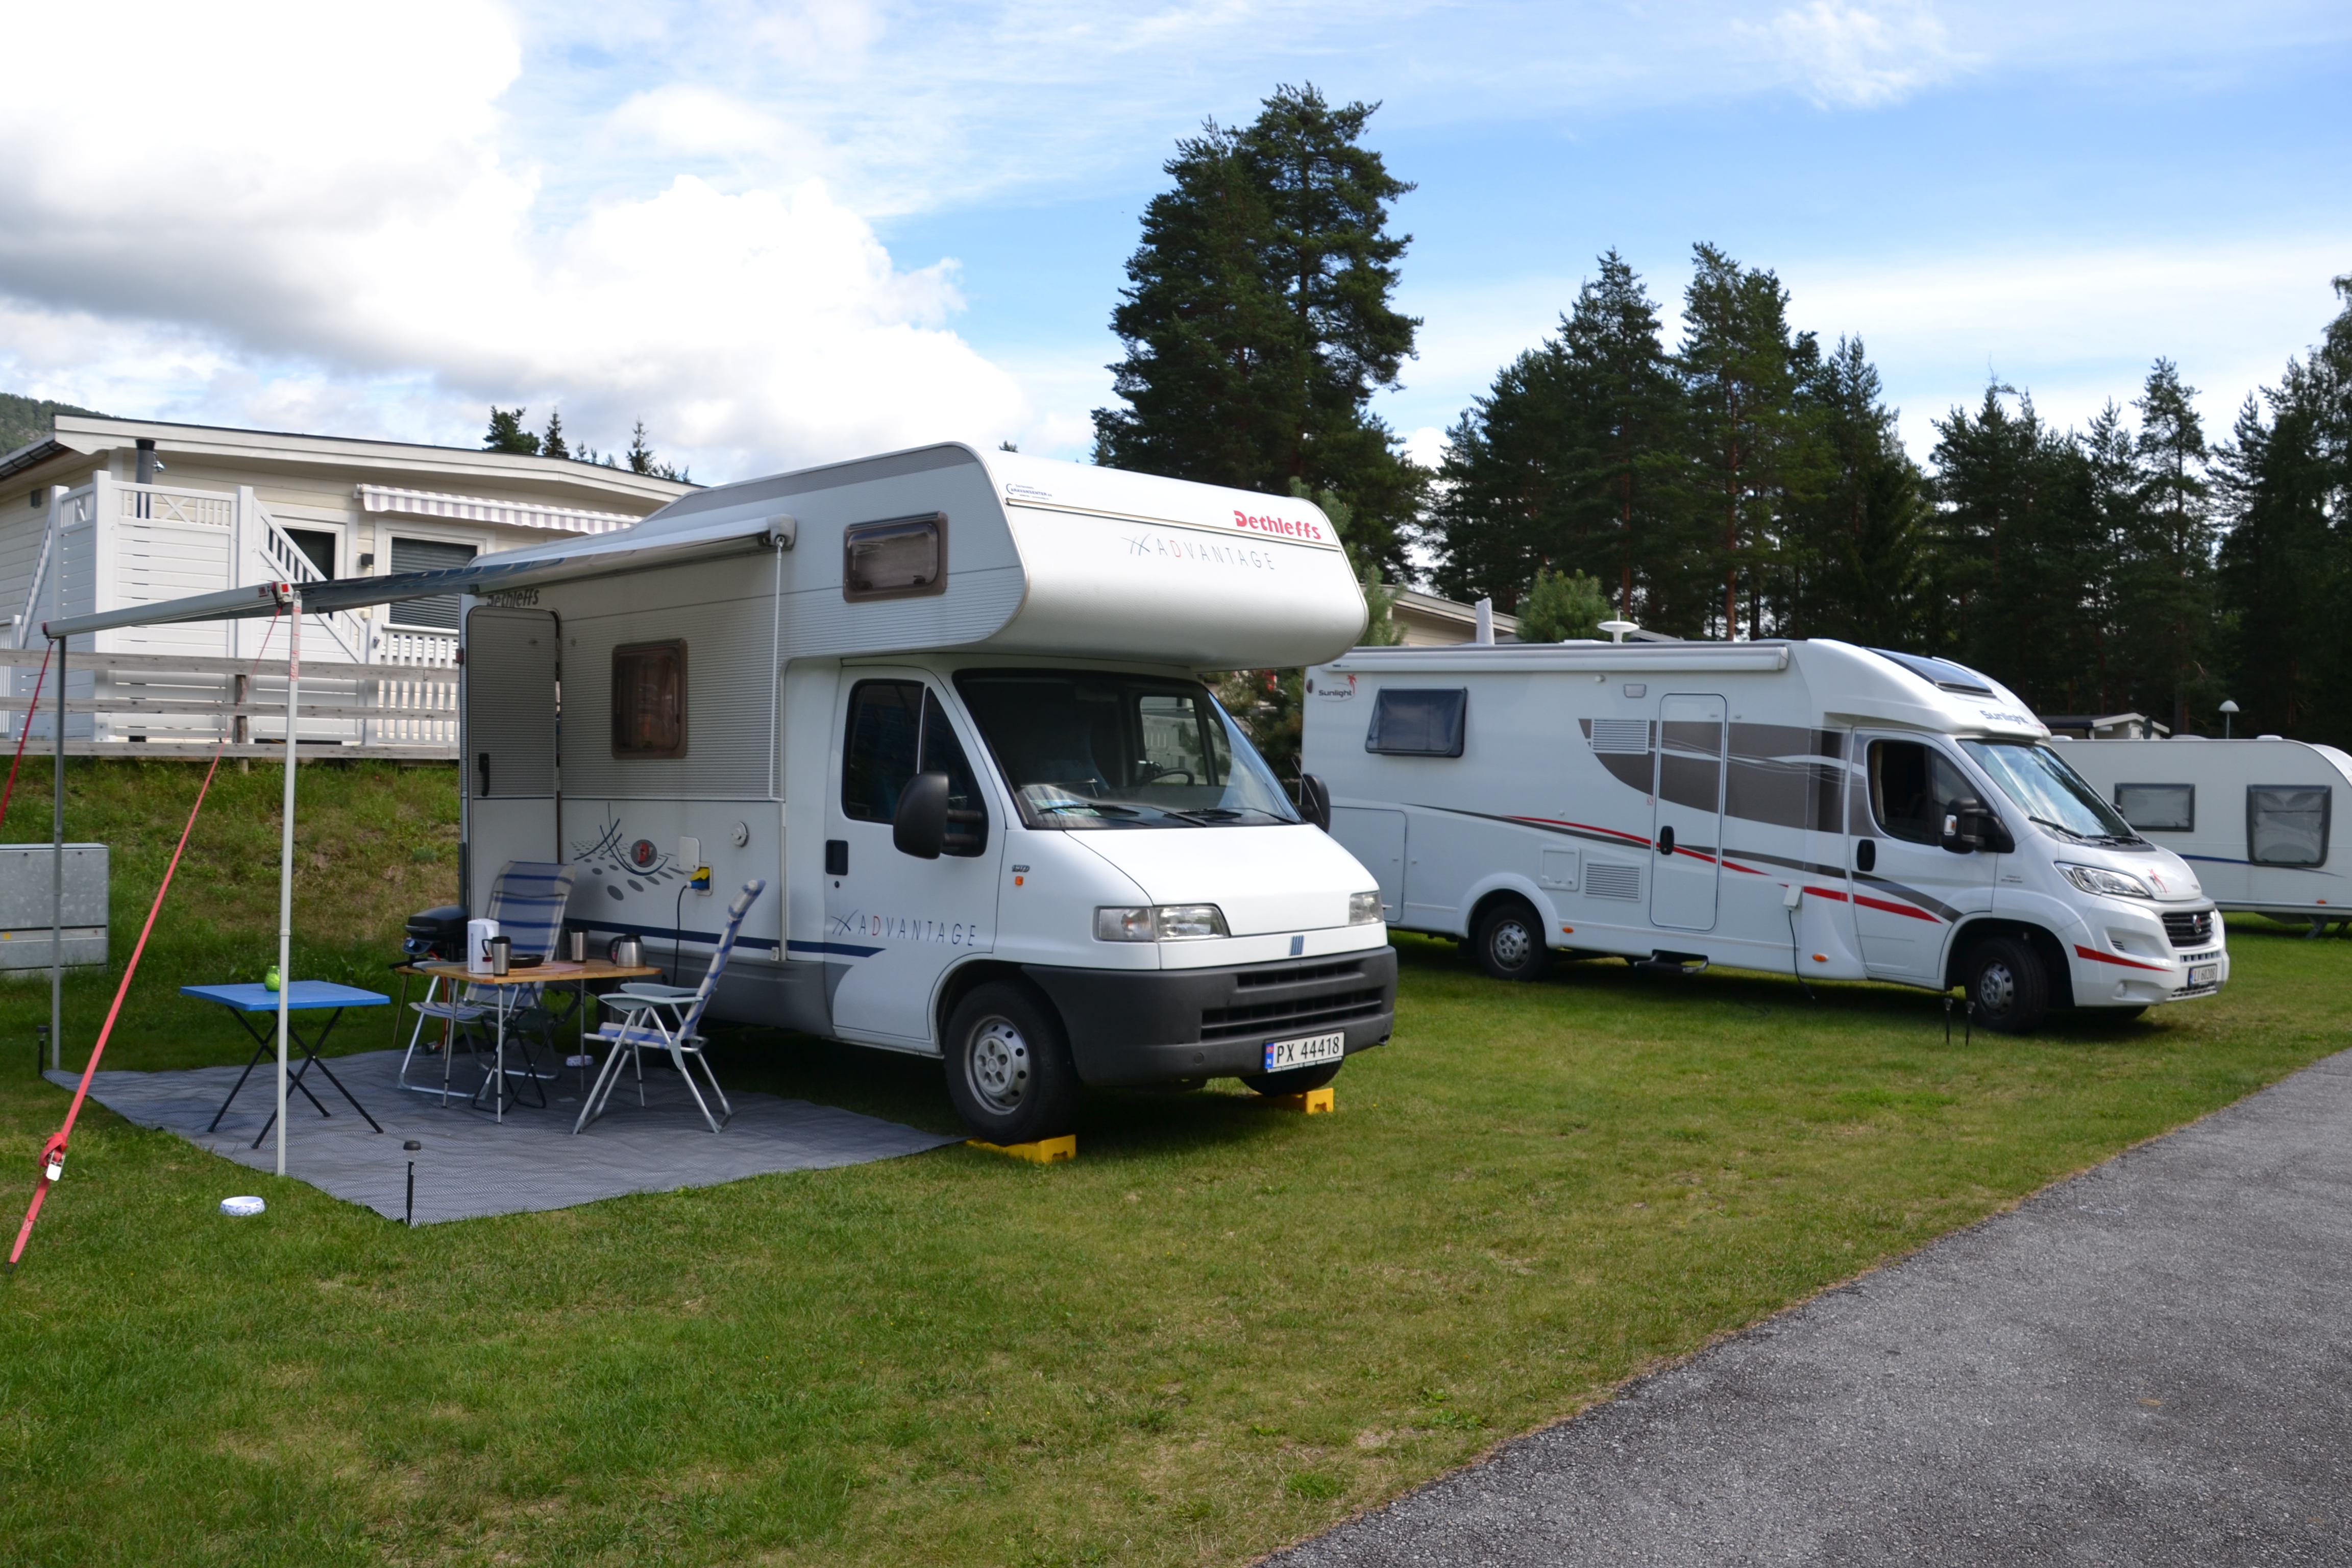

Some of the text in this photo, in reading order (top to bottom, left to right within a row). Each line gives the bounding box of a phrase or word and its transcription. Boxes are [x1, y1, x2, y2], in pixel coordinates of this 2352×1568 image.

[1233, 510, 1321, 540] Dethleffs
[1158, 538, 1275, 571] ADVANTAGE
[1318, 690, 1353, 698] Sunlight
[1979, 710, 2029, 725] Sunlight
[858, 915, 976, 946] ADVANTAGE
[1277, 1036, 1339, 1064] PX 44418
